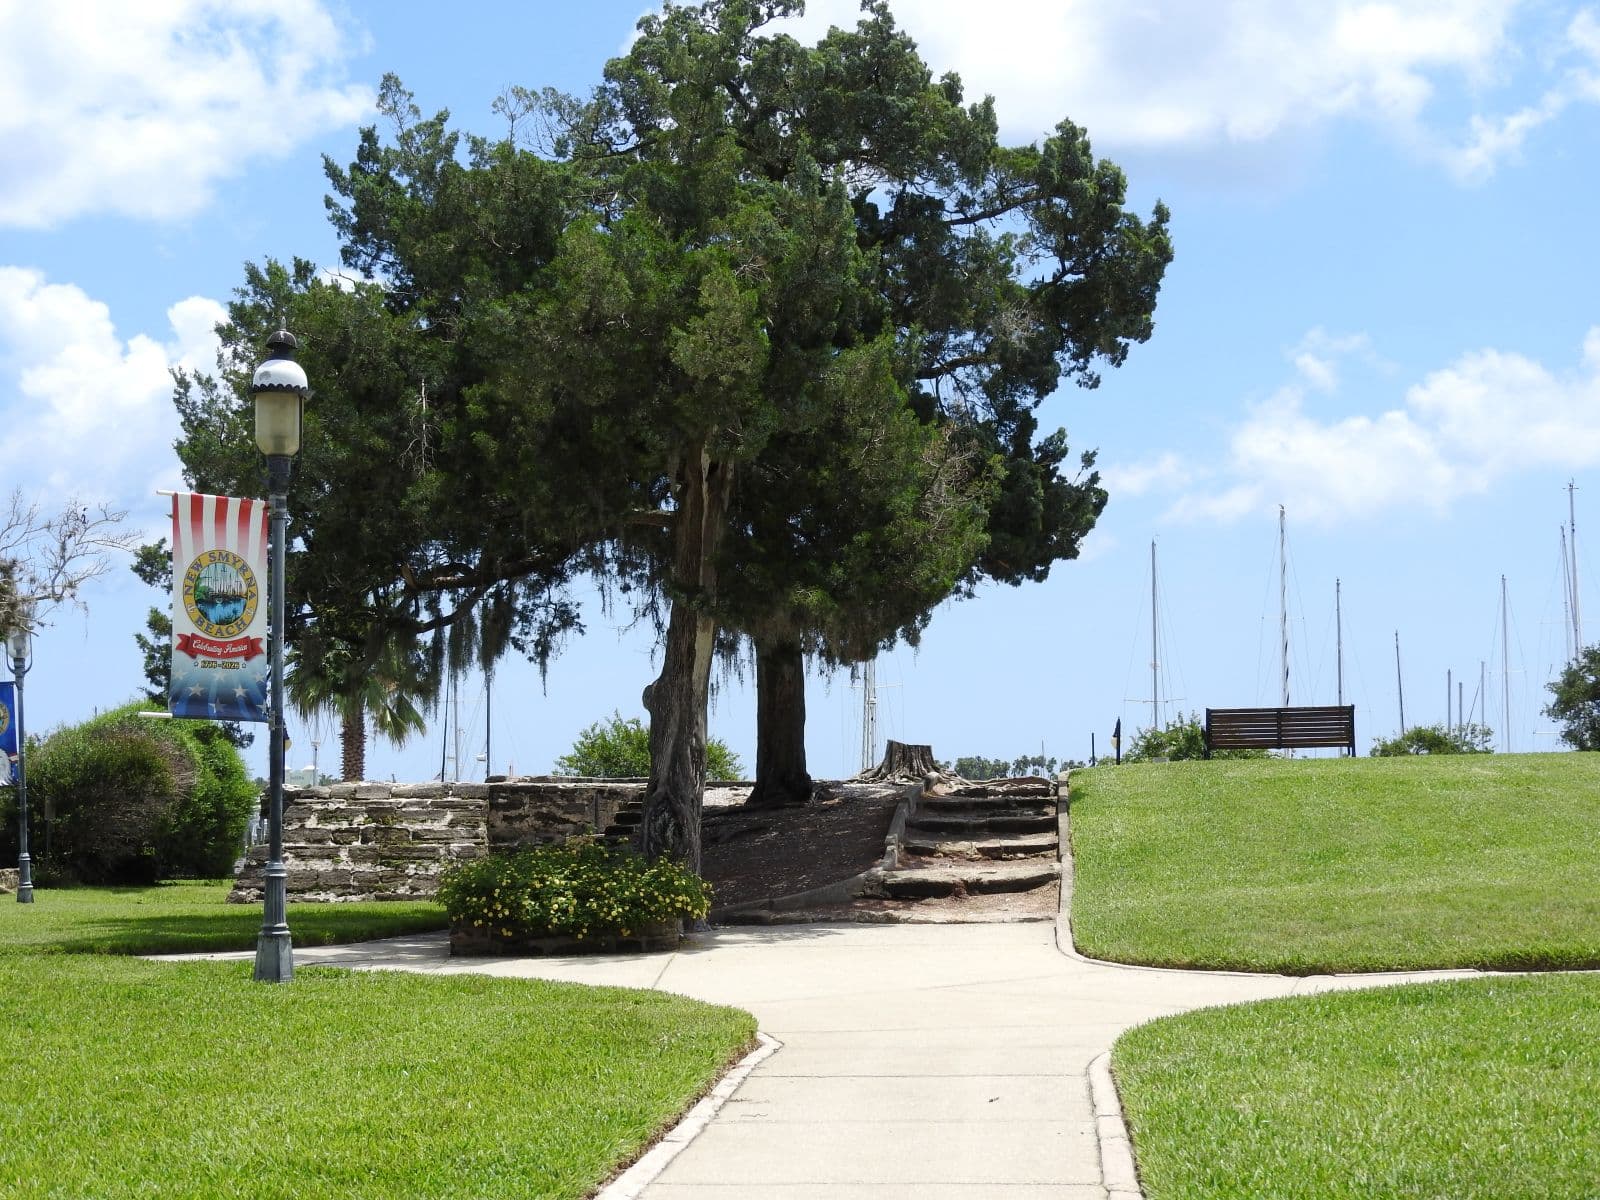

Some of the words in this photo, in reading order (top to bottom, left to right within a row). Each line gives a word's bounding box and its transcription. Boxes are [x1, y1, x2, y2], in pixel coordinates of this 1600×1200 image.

[184, 559, 203, 595] NEW
[208, 552, 256, 600] SMYRNA
[196, 617, 247, 636] BEACH
[193, 639, 223, 655] Celebrating
[224, 643, 248, 653] America
